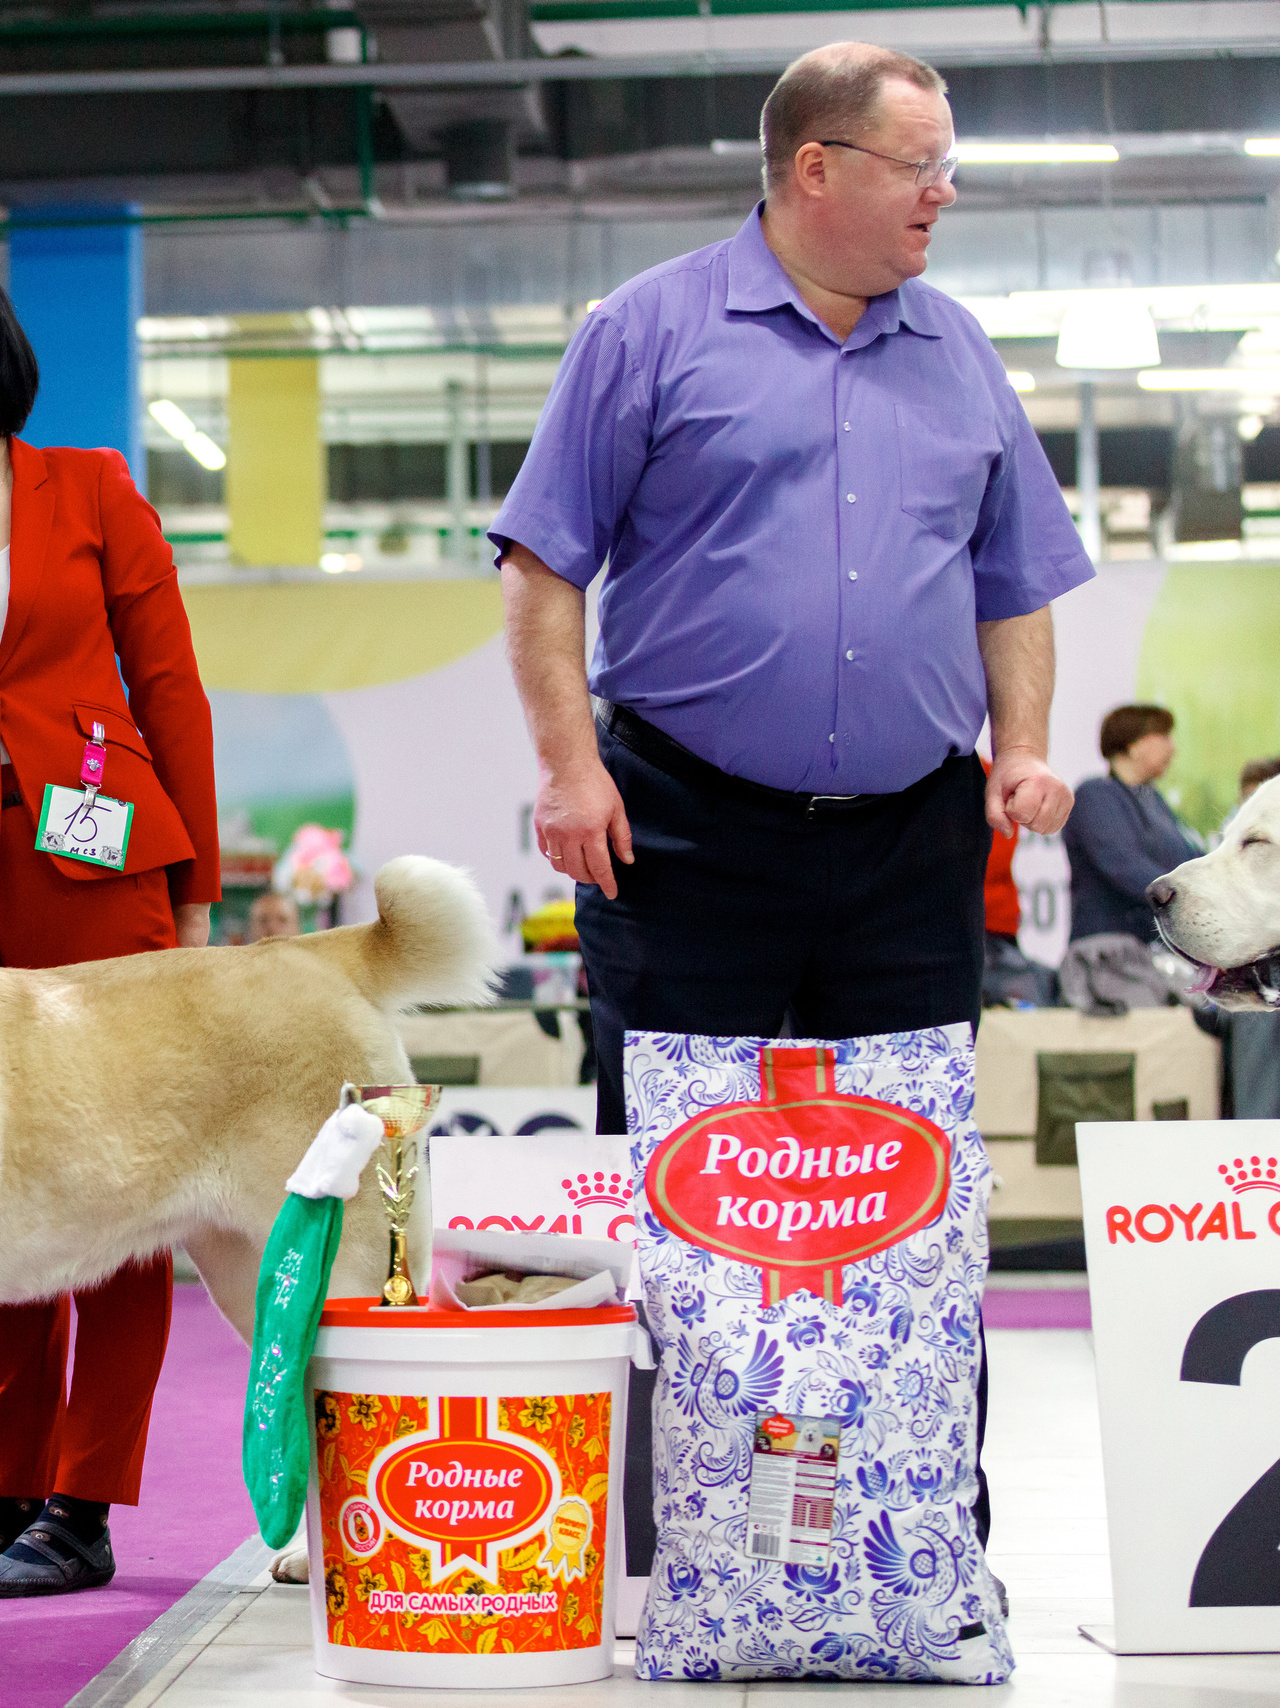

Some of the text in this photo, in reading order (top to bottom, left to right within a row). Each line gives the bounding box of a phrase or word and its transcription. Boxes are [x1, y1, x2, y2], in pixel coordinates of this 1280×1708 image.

[64, 802, 112, 843] 15
[700, 1133, 902, 1180] Родные
[716, 1191, 888, 1242] корма
[1106, 1201, 1257, 1245] ROYAL
[405, 1460, 524, 1488] Родные
[414, 1499, 515, 1526] корма
[558, 1527, 581, 1540] КЛАСС
[370, 1592, 556, 1615] ДЛЯ САМЫХ РОДНЫХ
